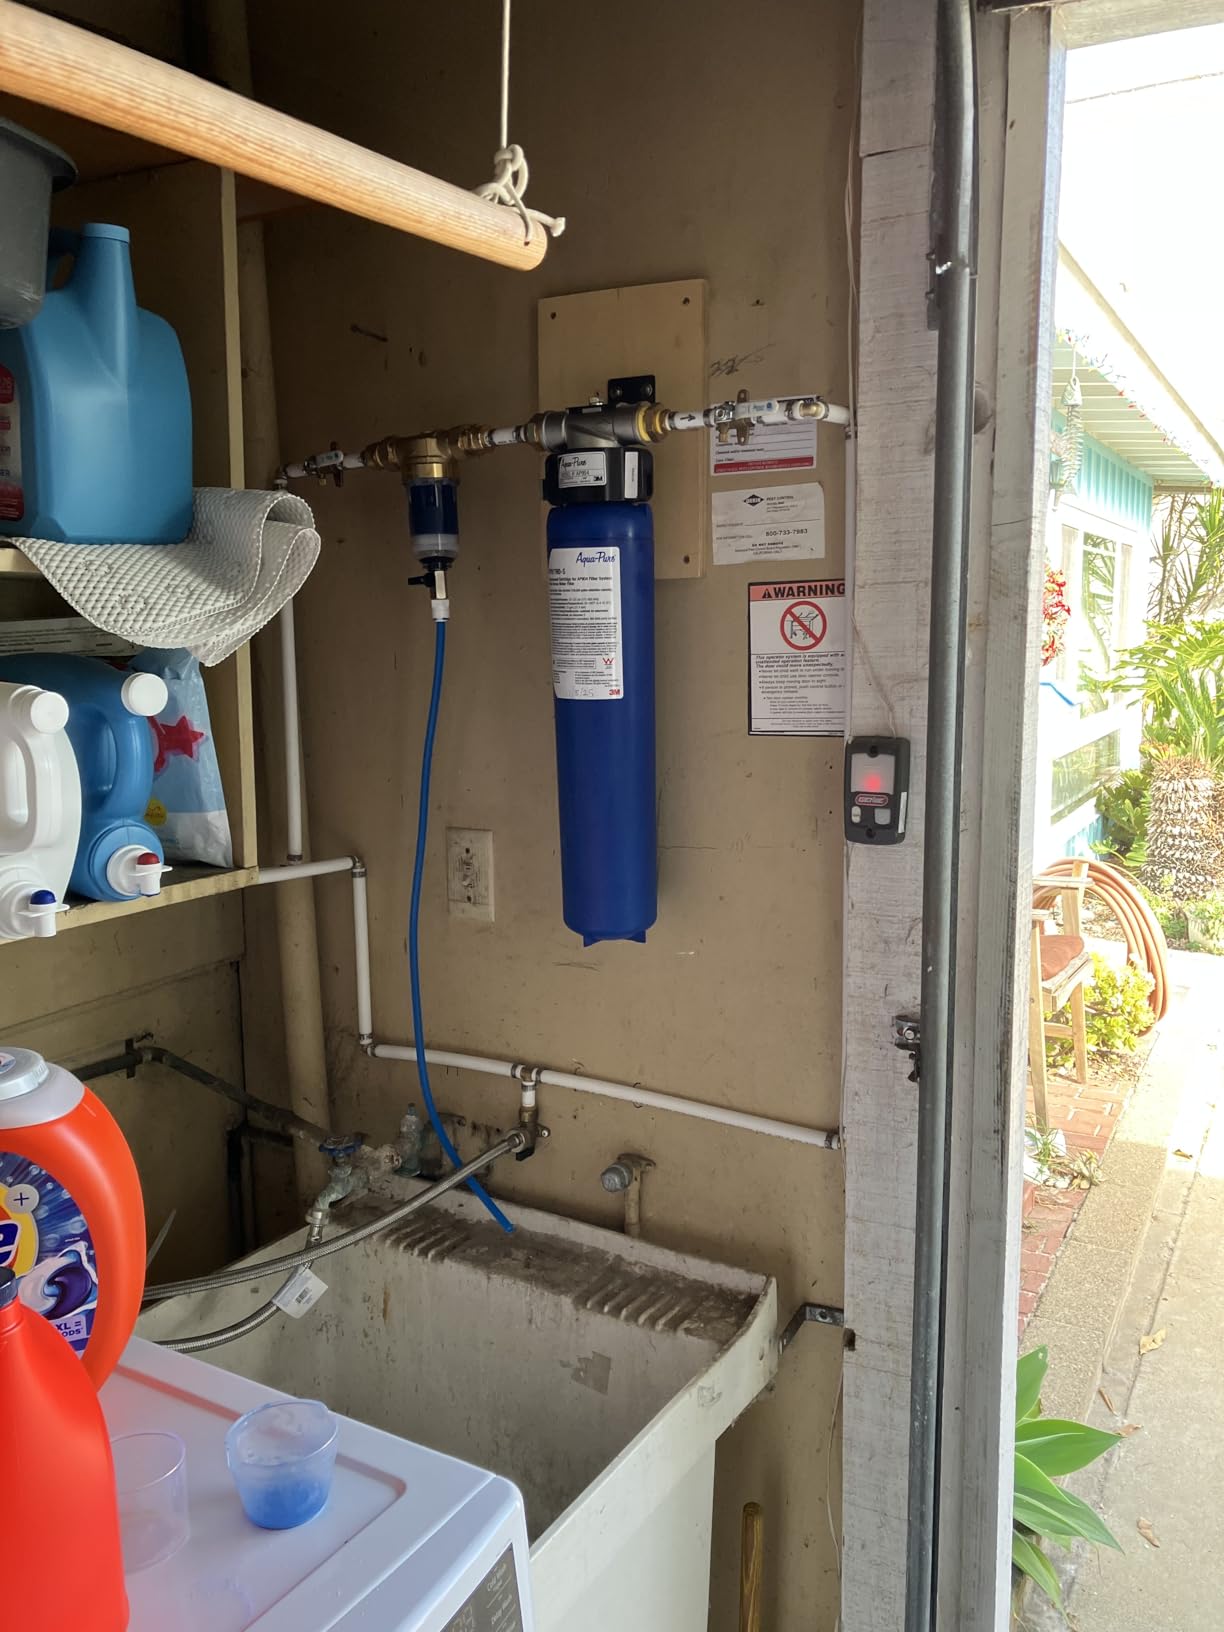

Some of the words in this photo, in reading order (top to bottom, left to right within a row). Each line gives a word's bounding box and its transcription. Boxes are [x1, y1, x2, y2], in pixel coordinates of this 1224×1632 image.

[576, 551, 616, 567] Aqua-Pure
[774, 583, 845, 599] WARNING
[55, 1322, 72, 1331] XL
[61, 1328, 82, 1338] ODS
